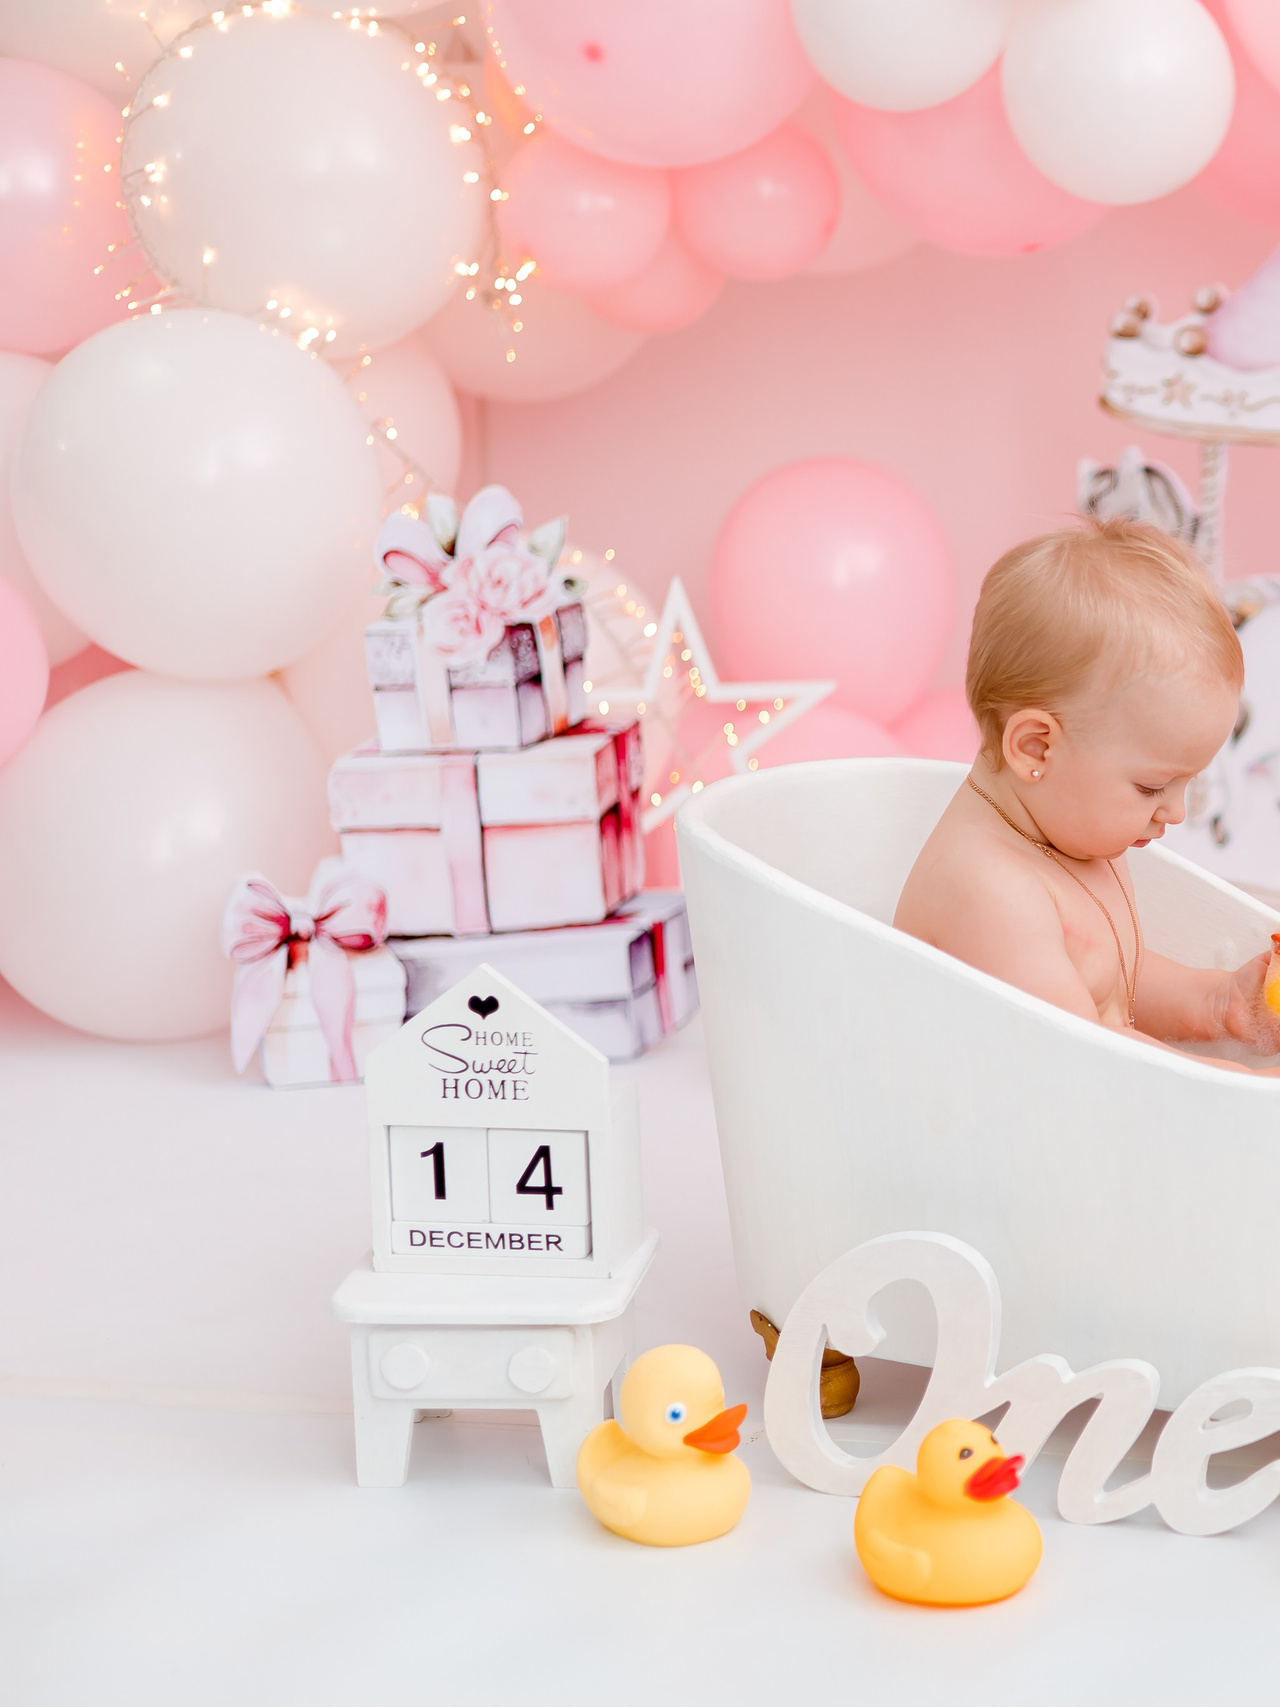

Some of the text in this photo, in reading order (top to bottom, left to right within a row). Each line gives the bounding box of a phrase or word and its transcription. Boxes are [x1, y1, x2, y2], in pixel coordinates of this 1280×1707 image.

[421, 1024, 538, 1074] Sweet
[475, 1031, 534, 1047] HOME
[441, 1078, 529, 1100] HOME
[408, 1229, 564, 1252] DECEMBER
